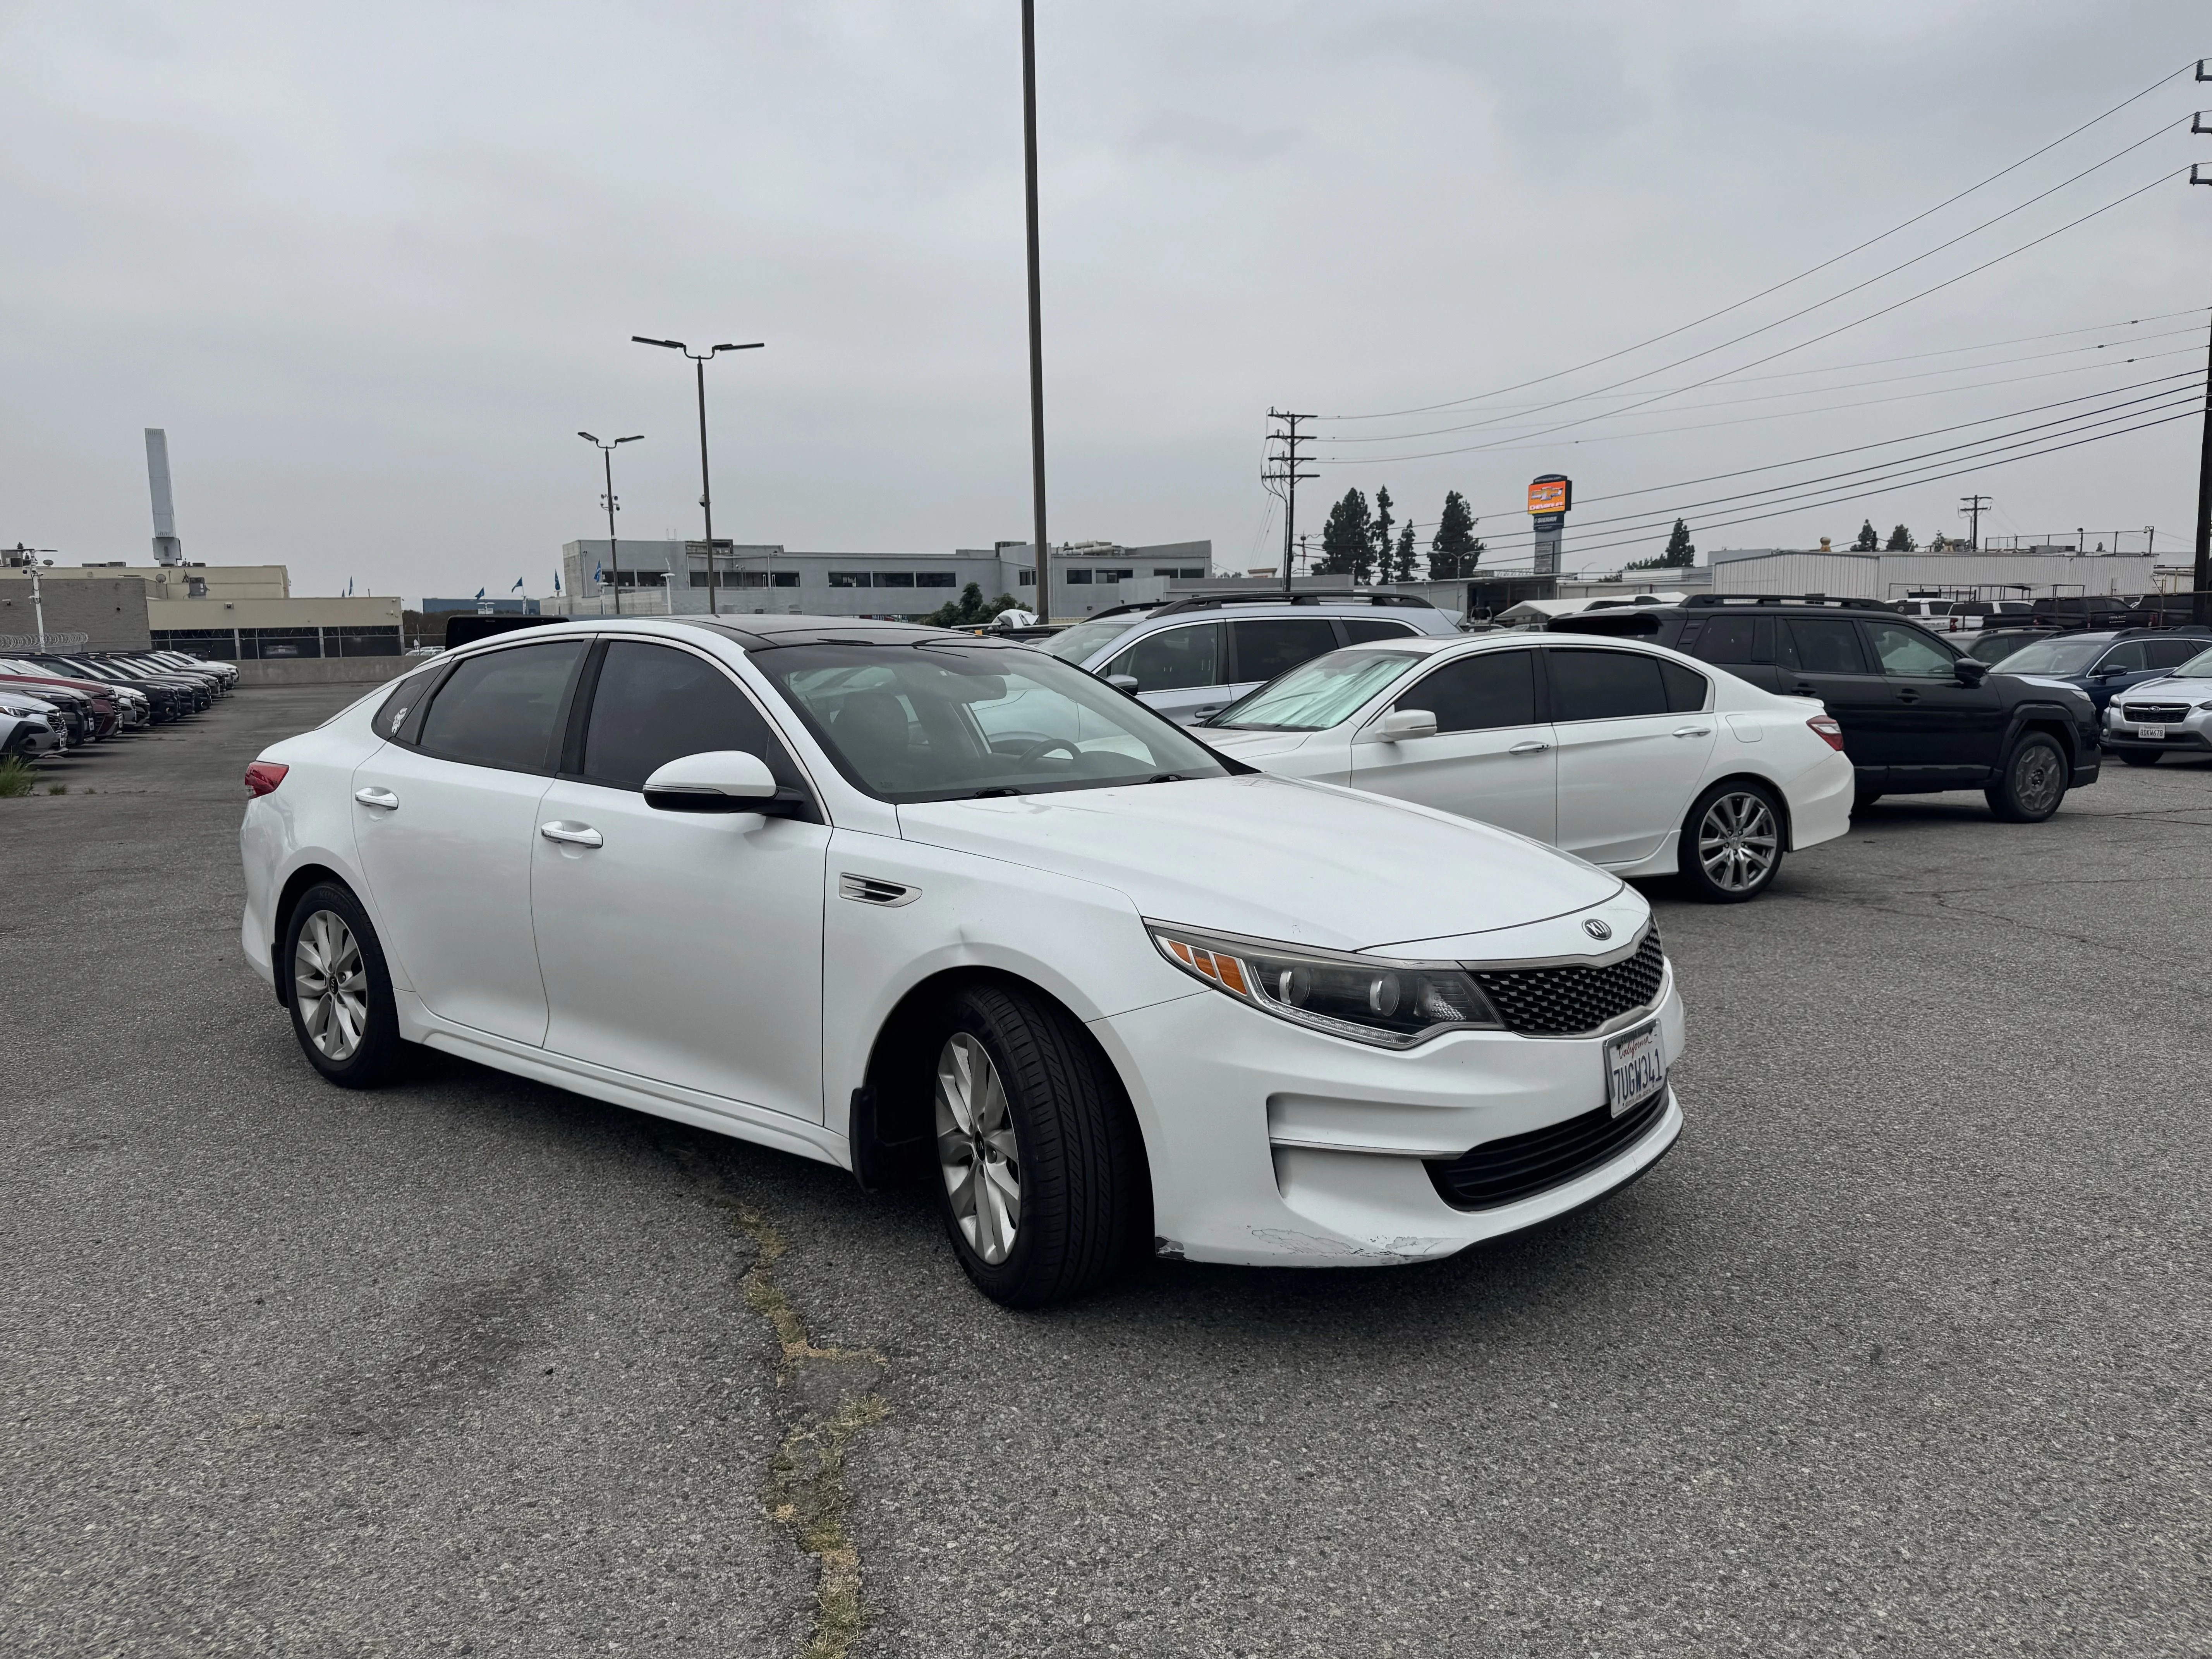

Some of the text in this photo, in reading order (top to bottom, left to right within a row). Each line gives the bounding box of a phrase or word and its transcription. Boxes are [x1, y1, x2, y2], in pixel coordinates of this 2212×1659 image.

[1586, 921, 1610, 936] KIA
[1619, 1035, 1652, 1059] California
[1614, 1048, 1662, 1104] 7UGW341
